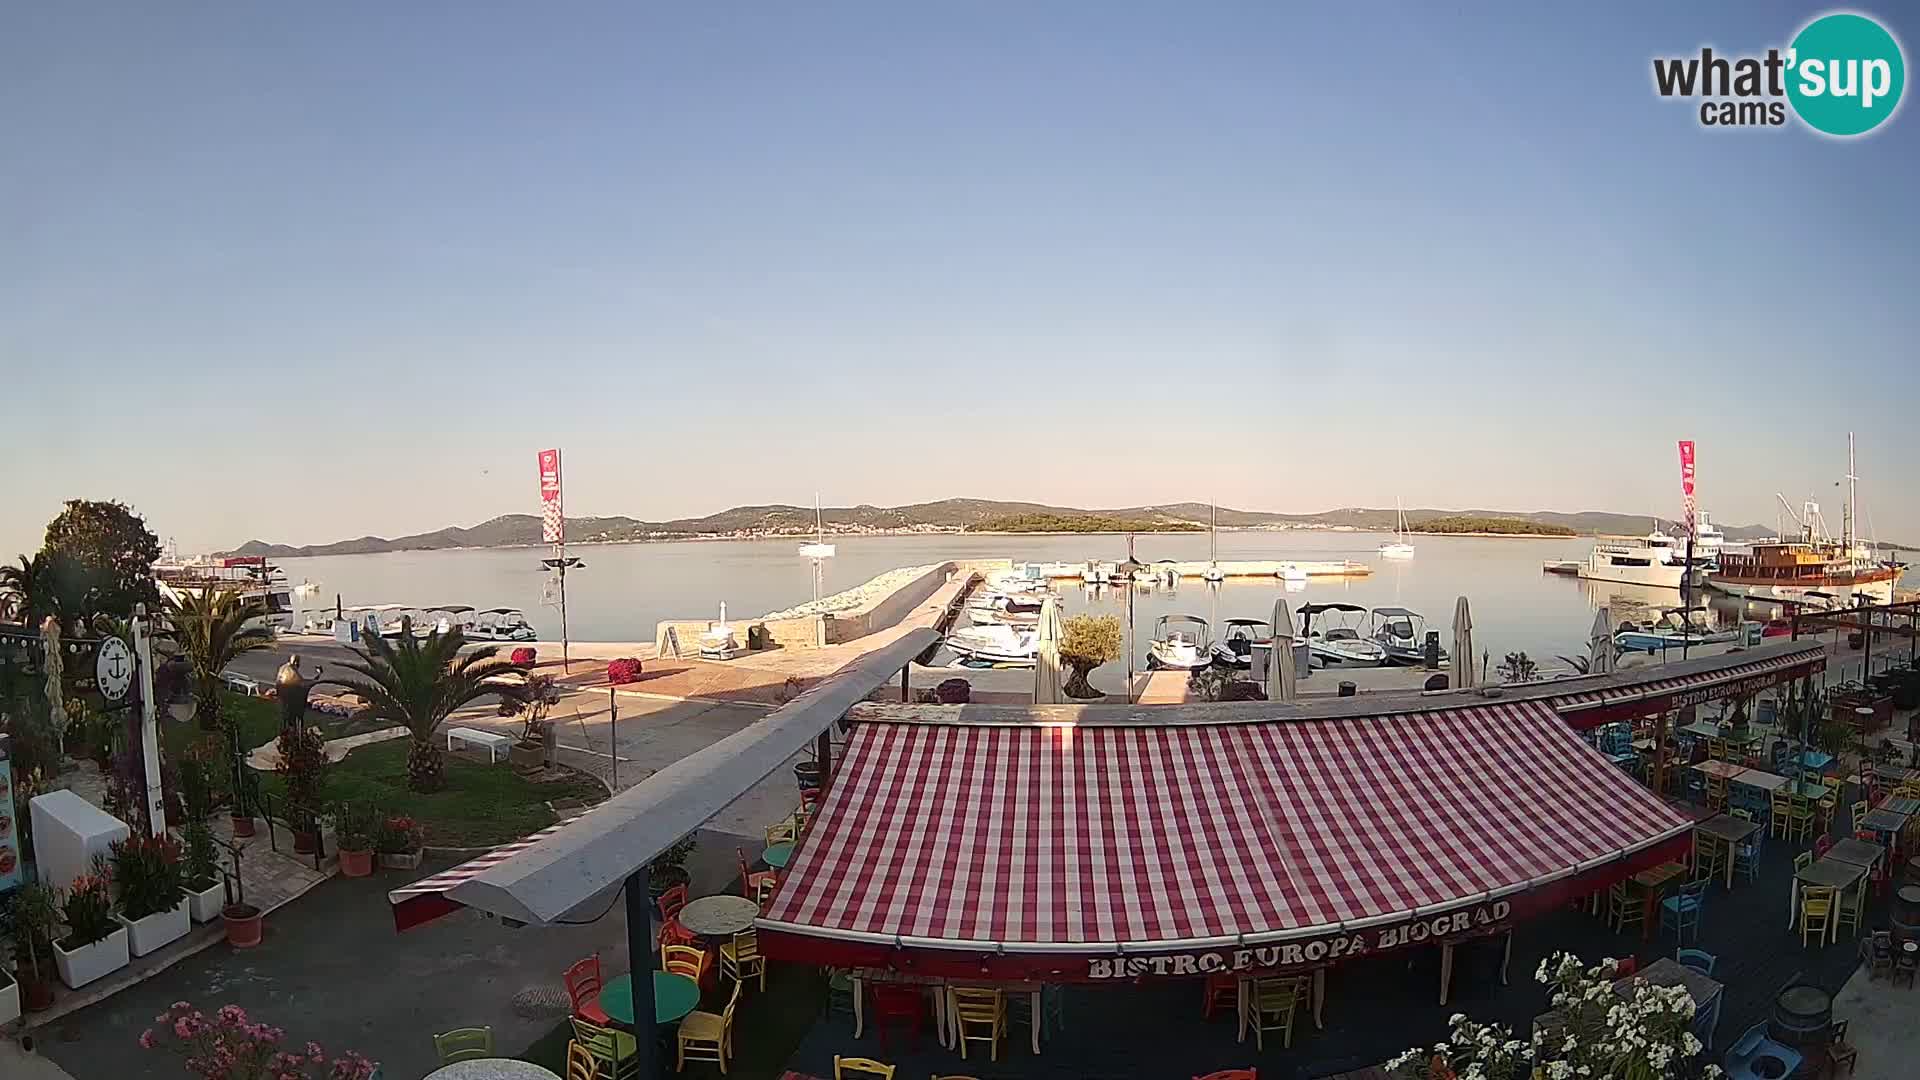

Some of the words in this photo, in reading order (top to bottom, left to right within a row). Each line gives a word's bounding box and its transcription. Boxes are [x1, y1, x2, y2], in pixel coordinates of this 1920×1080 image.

[1672, 691, 1706, 707] BISTRO
[1232, 934, 1367, 970] EUROPA
[1378, 901, 1511, 949] BIOGRAD
